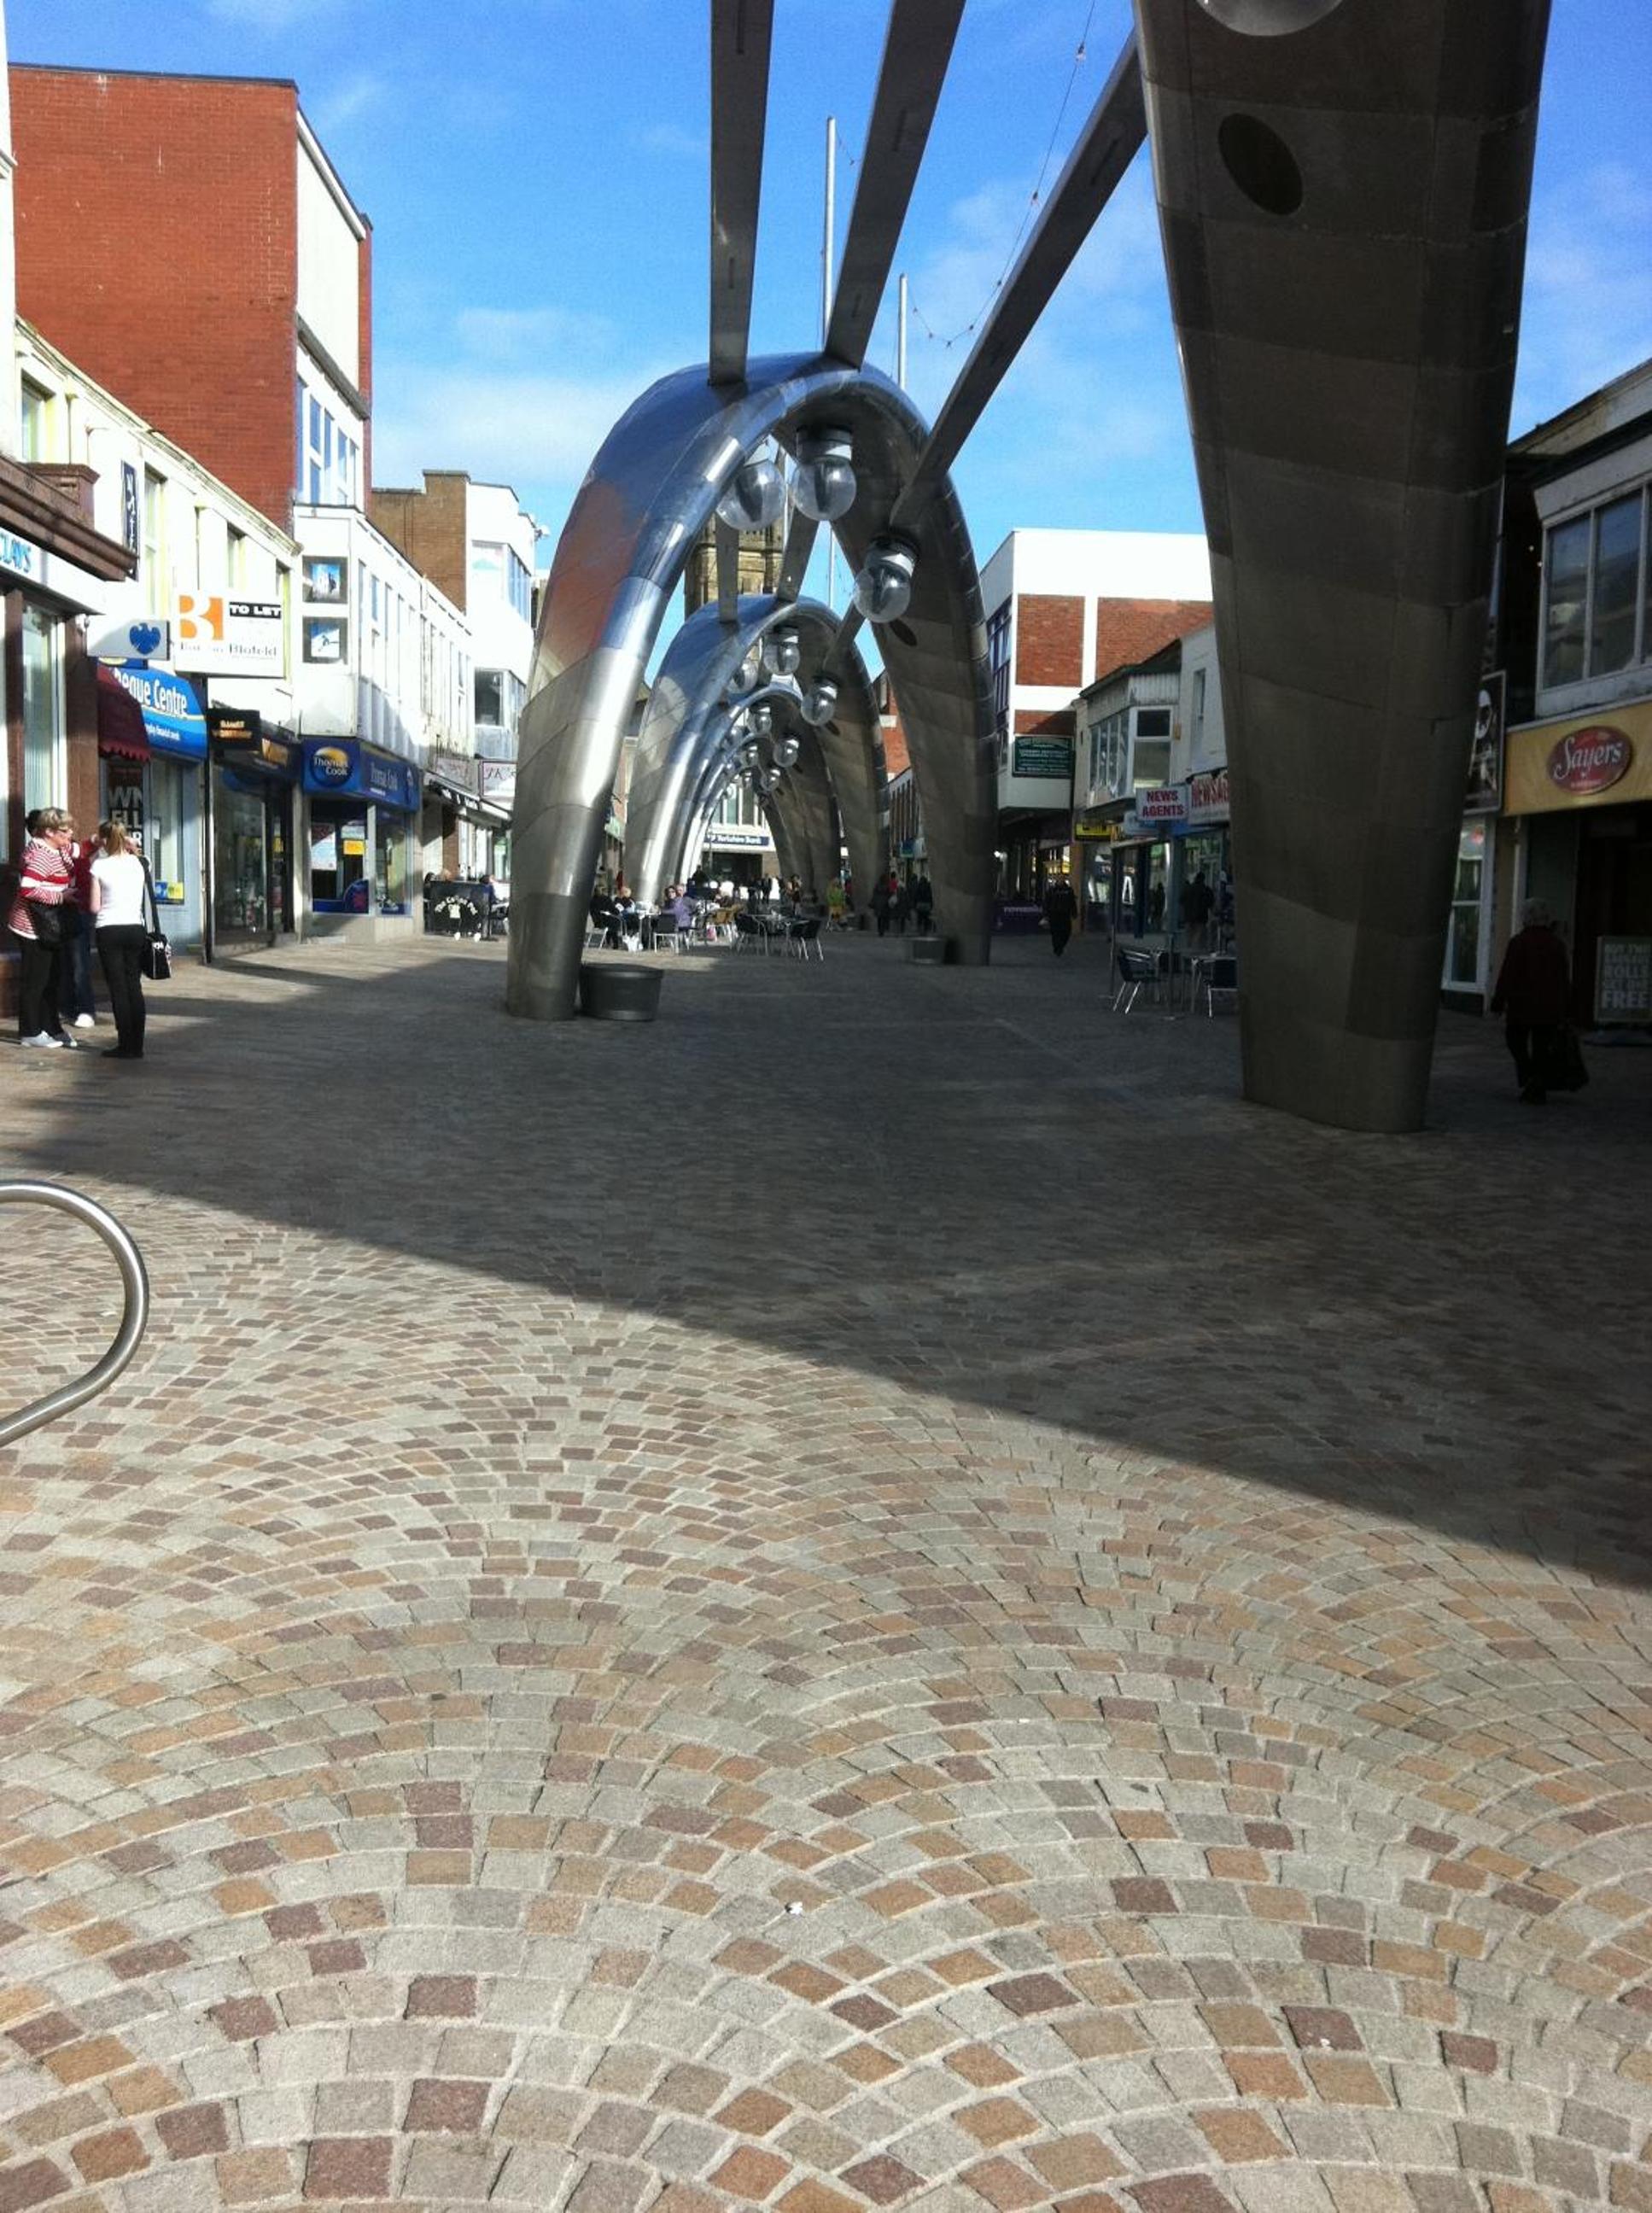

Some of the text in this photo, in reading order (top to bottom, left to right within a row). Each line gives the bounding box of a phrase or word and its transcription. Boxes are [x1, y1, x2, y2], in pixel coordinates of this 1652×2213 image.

[230, 604, 282, 616] TO LET
[154, 679, 188, 715] Centre
[313, 756, 349, 768] Thomas
[1553, 735, 1622, 780] Sayers
[325, 767, 348, 776] Cook
[1146, 790, 1179, 803] NEWS
[1141, 804, 1185, 818] AGENTS
[1604, 965, 1649, 978] ROLLS
[1601, 990, 1652, 1009] FREE
